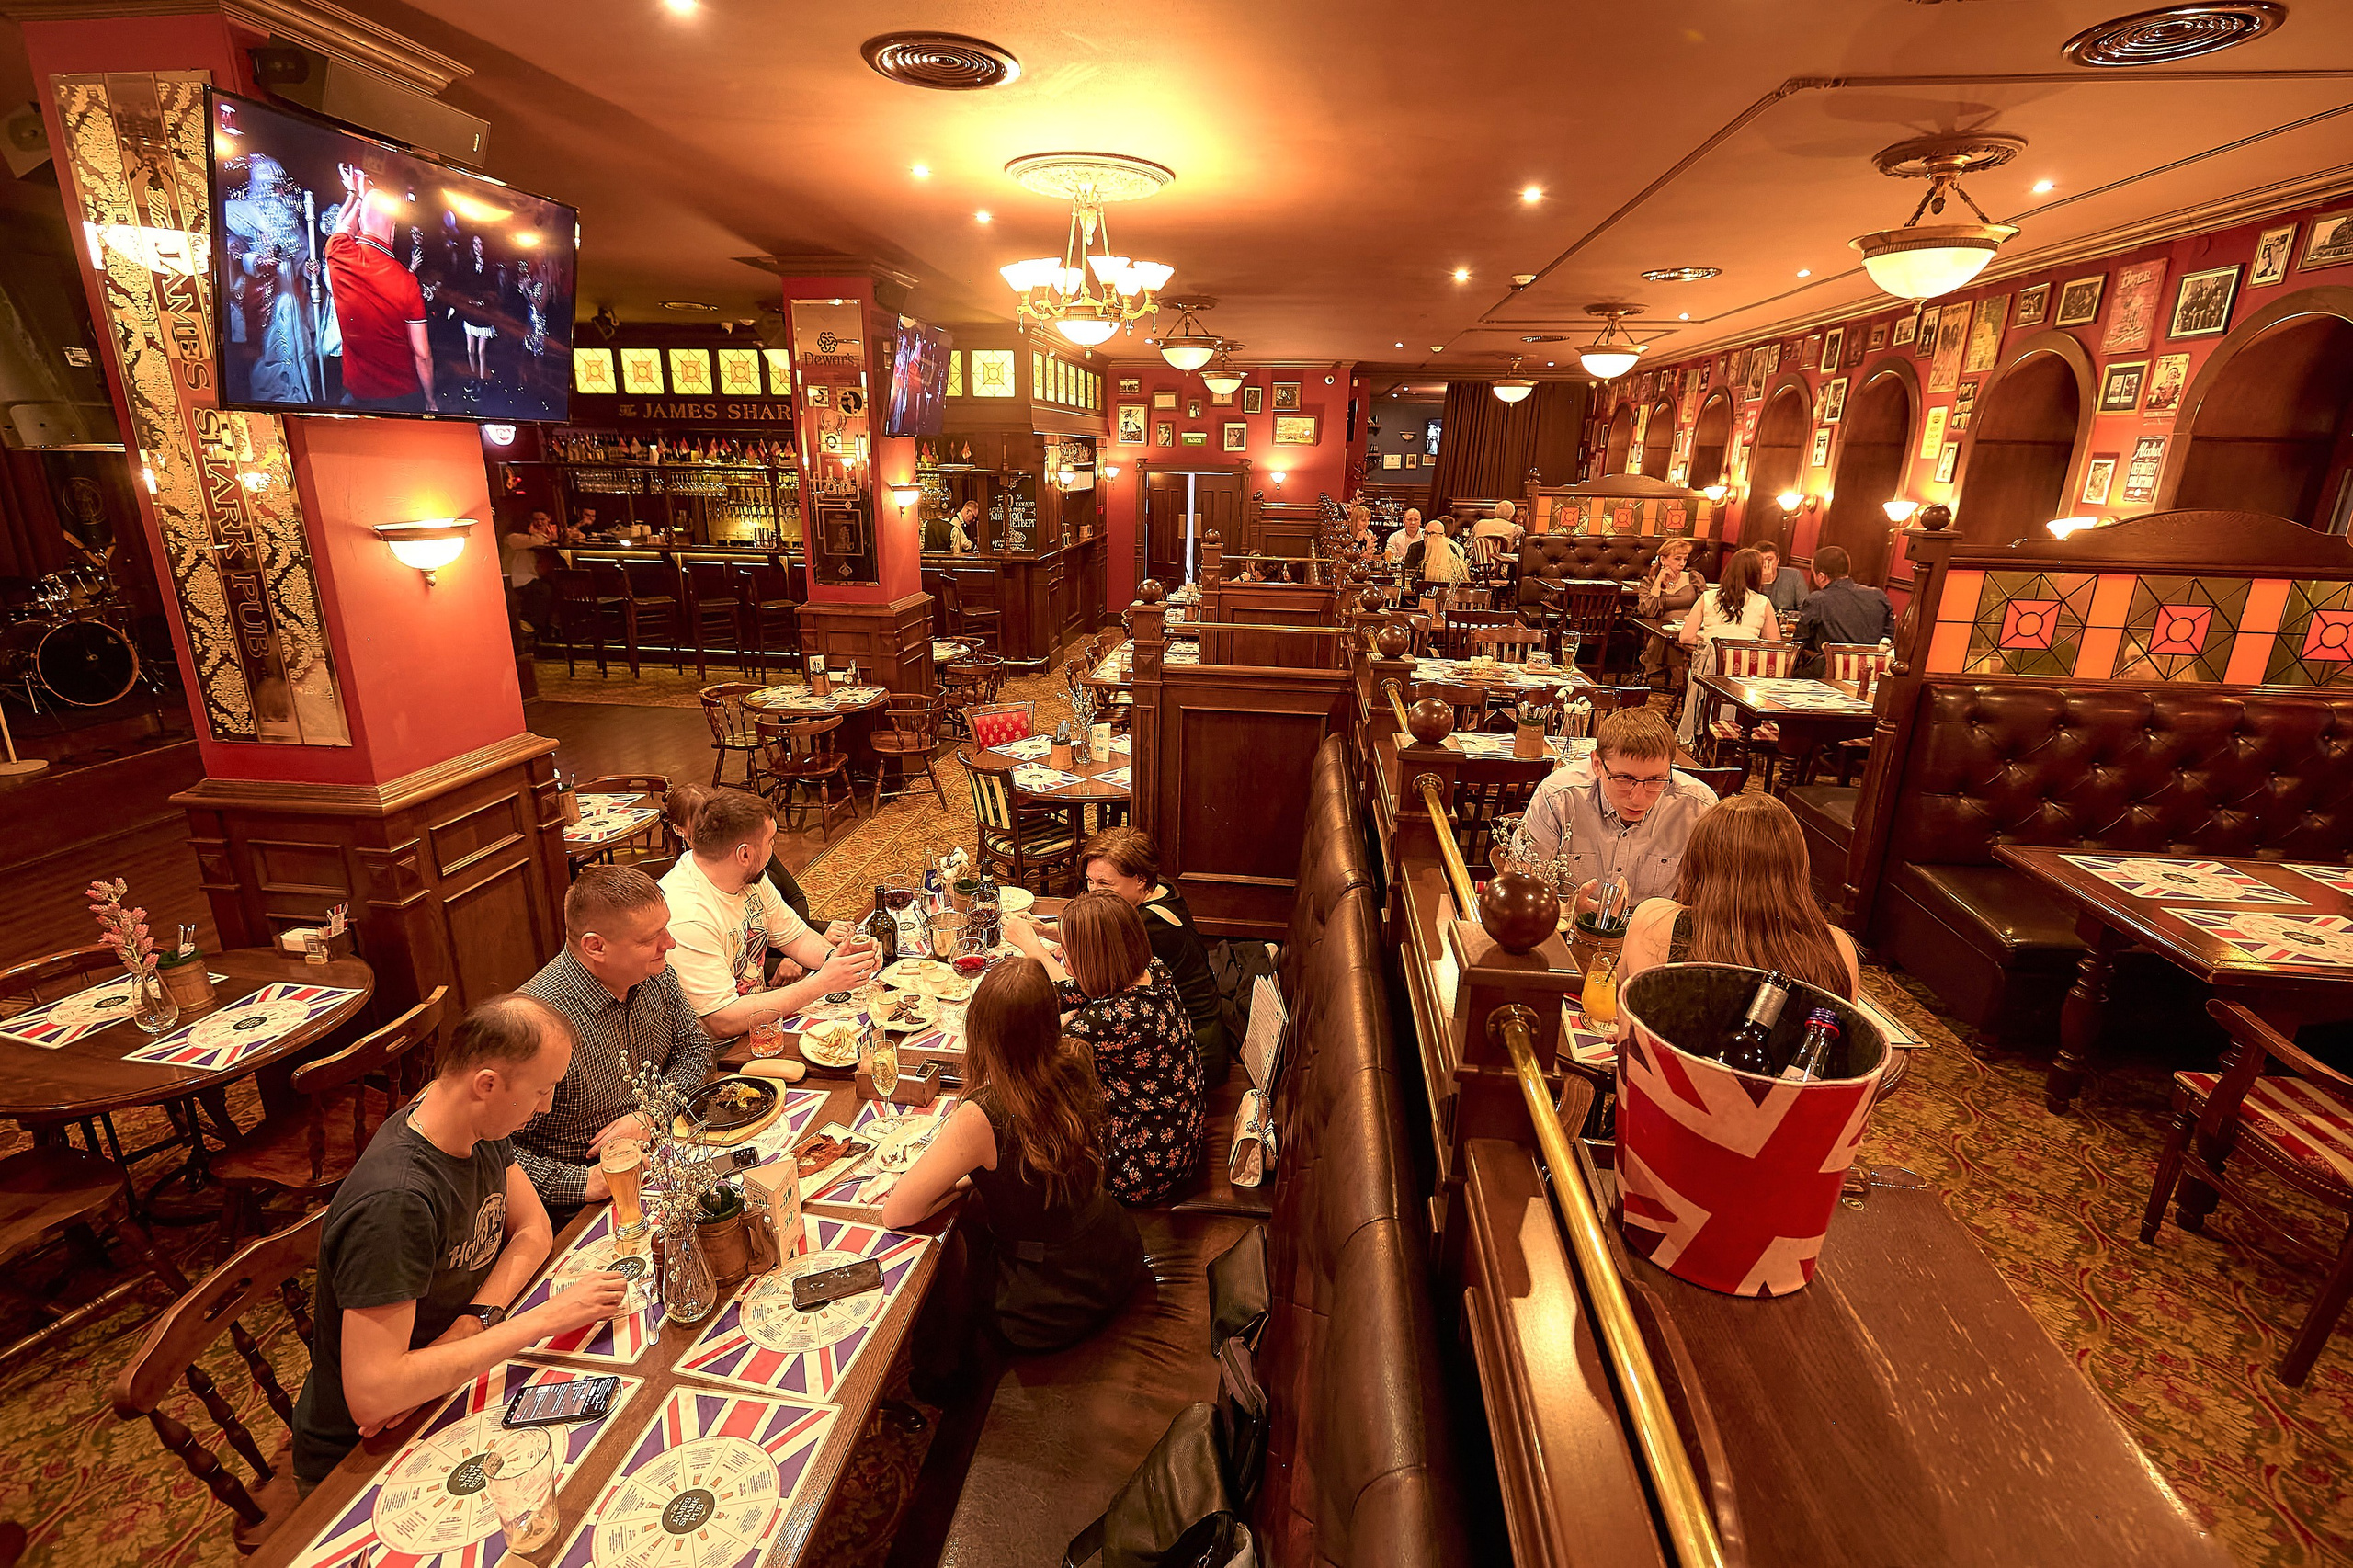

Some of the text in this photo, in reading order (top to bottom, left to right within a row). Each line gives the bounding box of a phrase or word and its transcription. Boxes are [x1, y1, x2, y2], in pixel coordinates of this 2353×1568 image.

[803, 351, 855, 367] Dewar's
[643, 403, 718, 419] JAMES
[727, 403, 792, 421] SHAR
[154, 241, 211, 391] JAMES
[193, 407, 253, 560] SHARK
[231, 574, 270, 658] PUB
[672, 1497, 692, 1525] JAMES
[678, 1497, 700, 1527] SHARK
[689, 1503, 704, 1521] PUB
